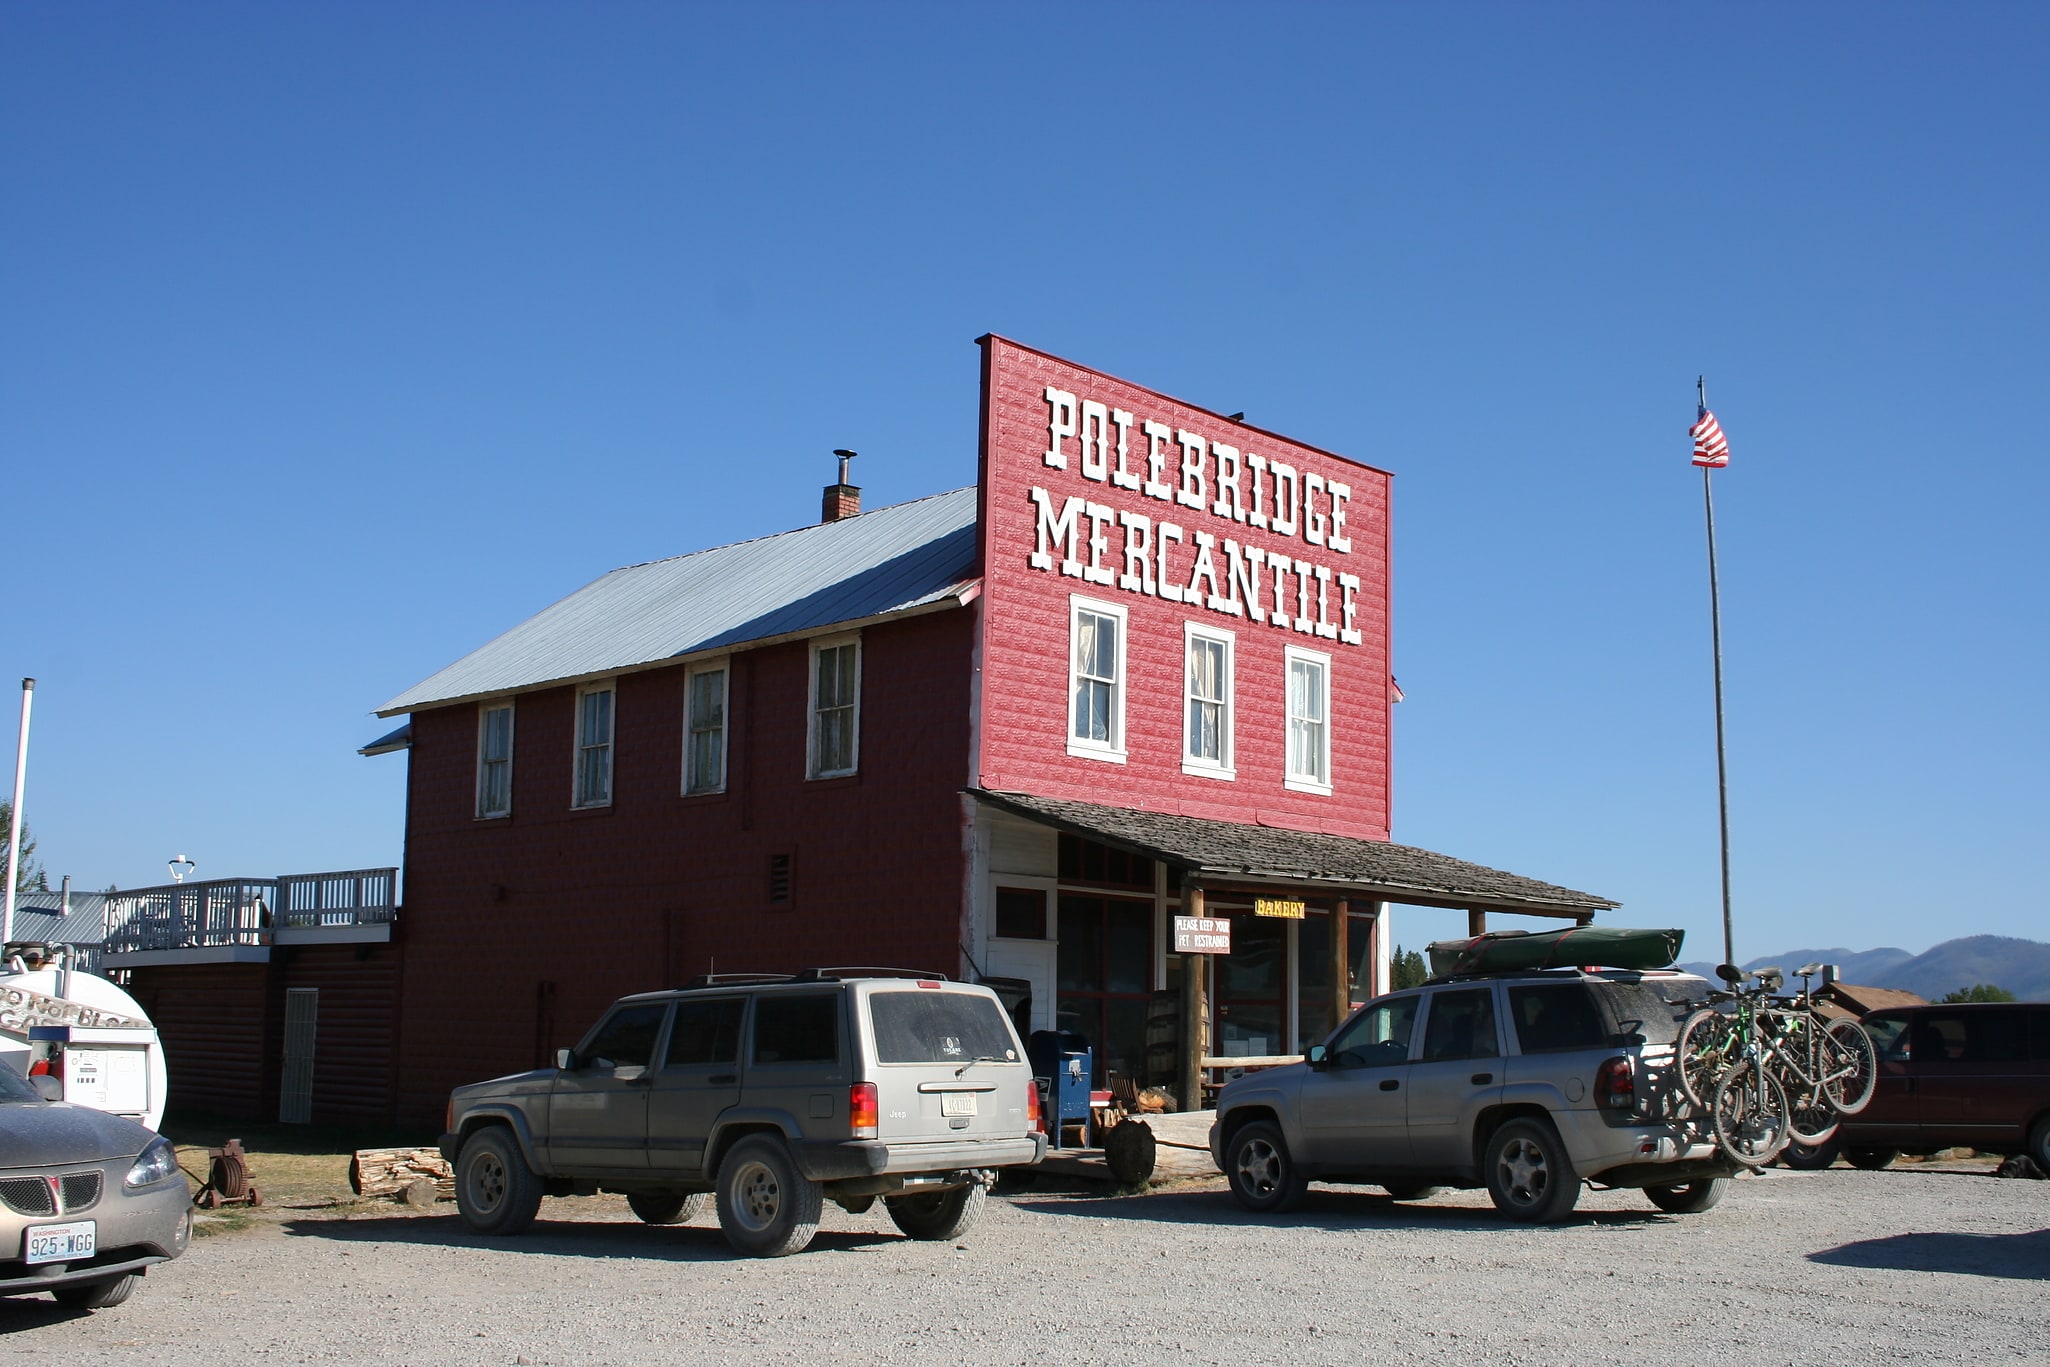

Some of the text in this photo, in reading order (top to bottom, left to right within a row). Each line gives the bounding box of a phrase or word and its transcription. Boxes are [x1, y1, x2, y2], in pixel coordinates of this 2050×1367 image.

[1044, 386, 1352, 554] POLEBRIDGE
[1030, 486, 1362, 646] MERCANTILE
[1257, 899, 1305, 918] BAKERY
[1176, 919, 1230, 933] PLEASE KEEP YOUR
[1178, 934, 1230, 948] PET RESTRAINED
[889, 1110, 907, 1119] Jeep
[33, 1228, 71, 1237] WASHINGTON
